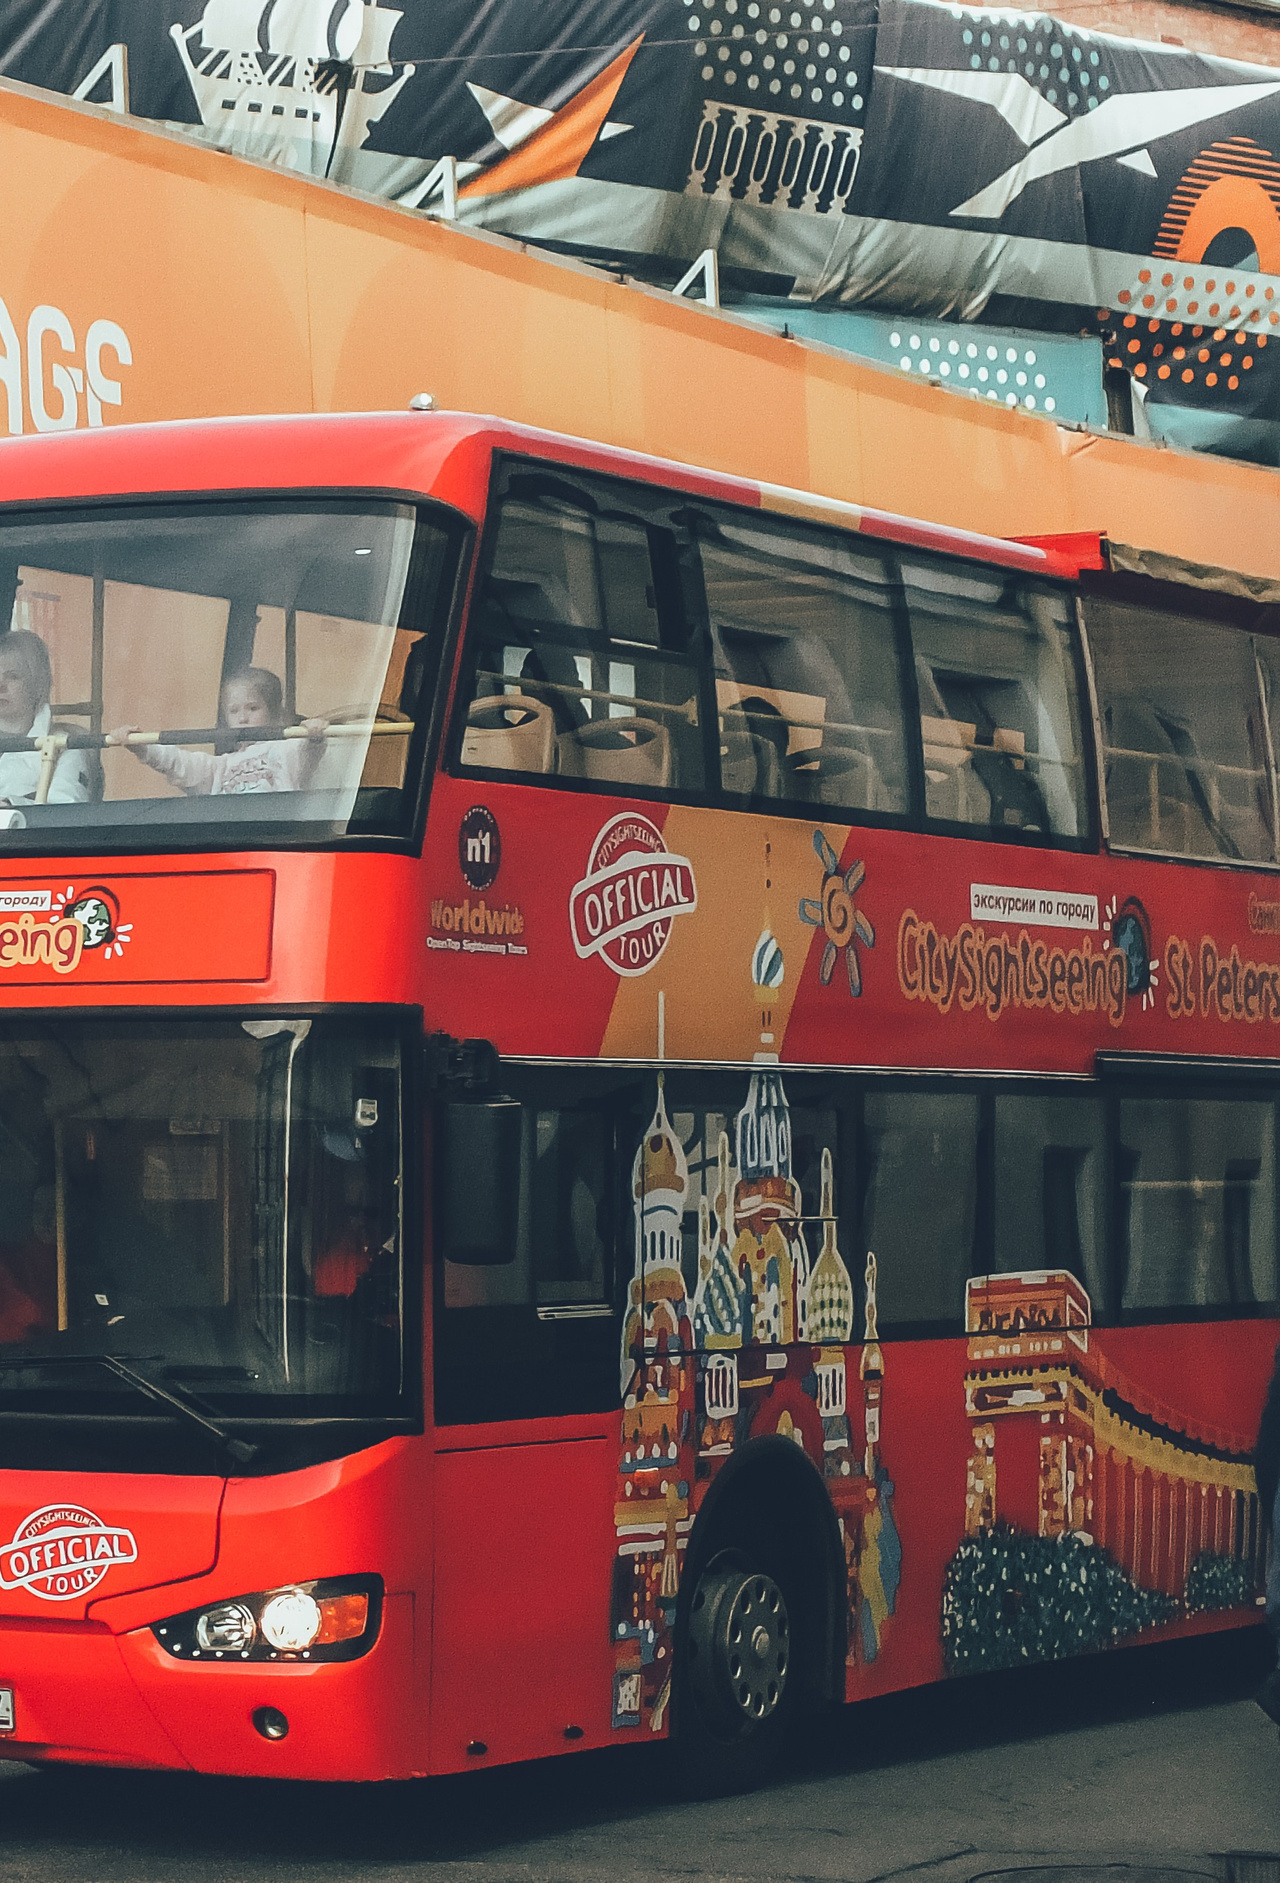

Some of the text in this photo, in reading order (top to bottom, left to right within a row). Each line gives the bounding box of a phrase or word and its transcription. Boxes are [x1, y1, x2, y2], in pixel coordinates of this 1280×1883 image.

[431, 899, 524, 935] Worldwide
[584, 866, 689, 936] OFFICIAL
[973, 892, 1096, 923] экскурсии по городу
[620, 921, 666, 964] TOUR
[1165, 935, 1196, 1019] St
[25, 1511, 96, 1539] CITYSIGHTSEEING
[9, 1534, 128, 1578] OFFICIAL
[46, 1567, 98, 1593] TOUR
